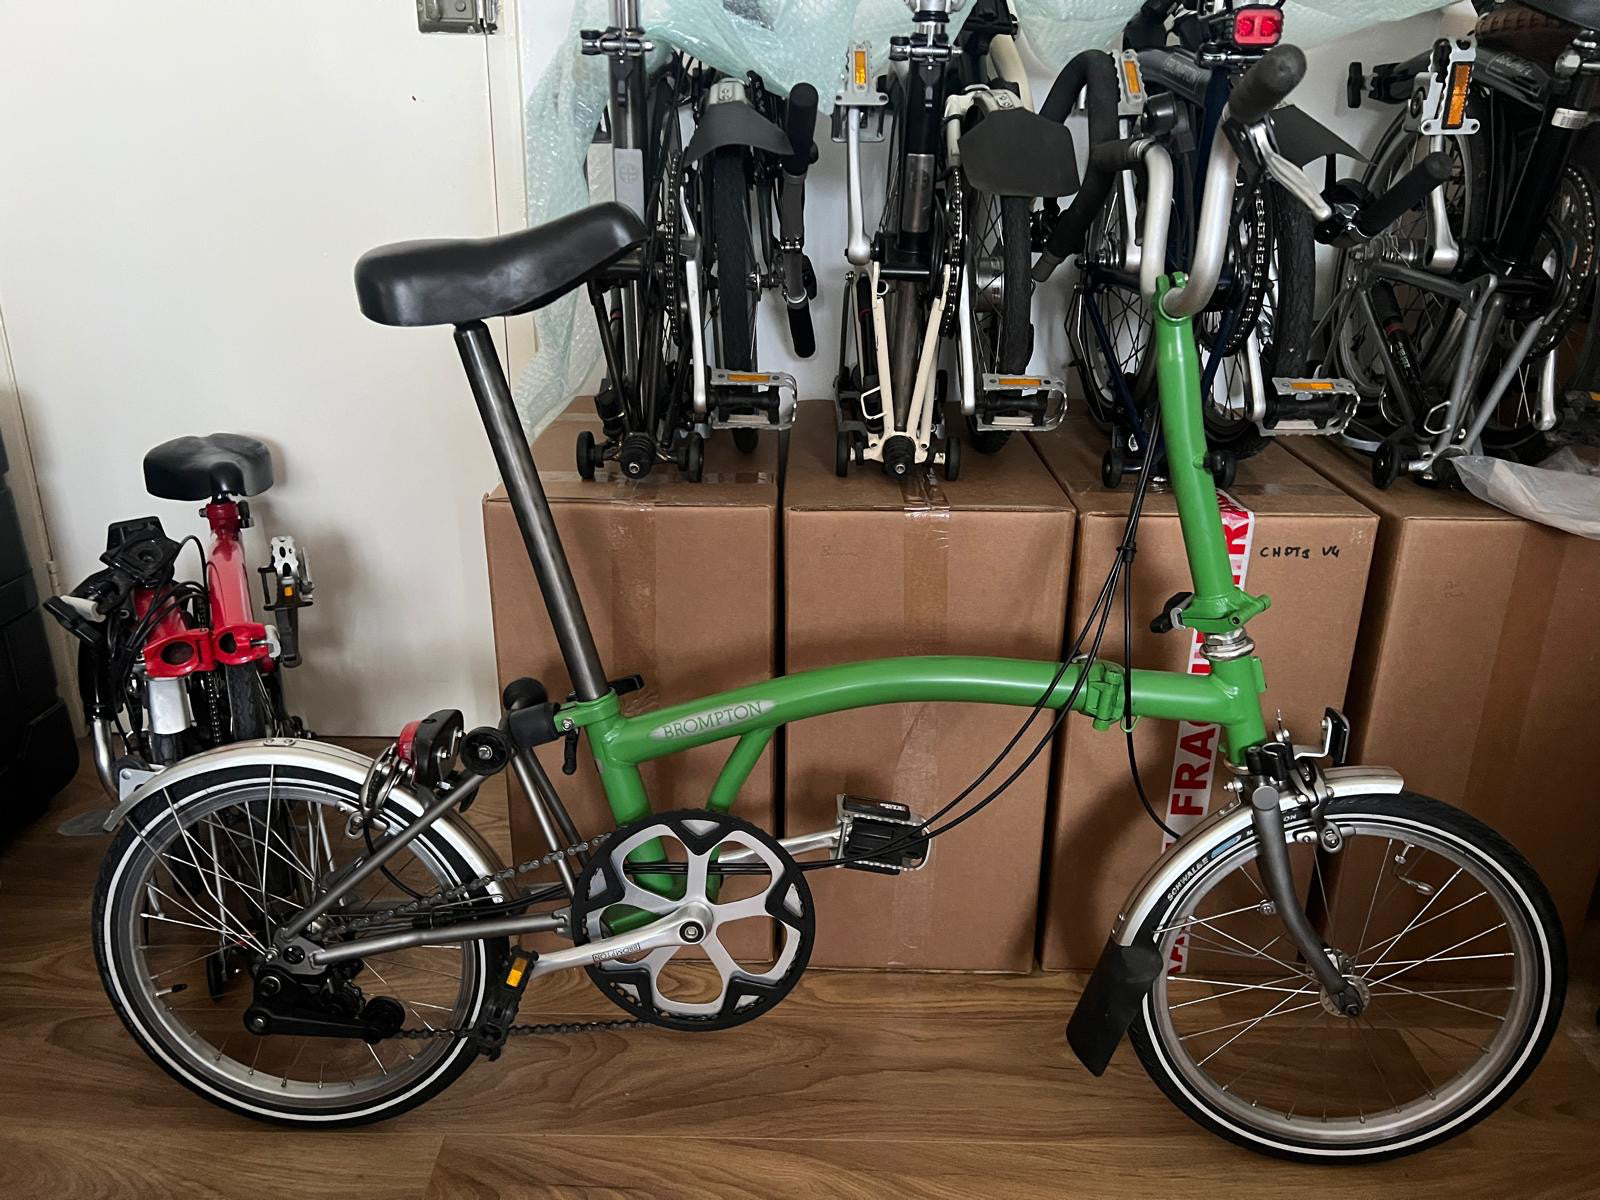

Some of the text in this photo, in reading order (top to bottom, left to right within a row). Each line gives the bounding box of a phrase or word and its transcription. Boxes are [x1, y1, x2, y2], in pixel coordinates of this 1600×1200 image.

[663, 701, 763, 739] BROMPTON
[1170, 721, 1217, 816] FRA
[1166, 857, 1210, 902] SCHWALBE
